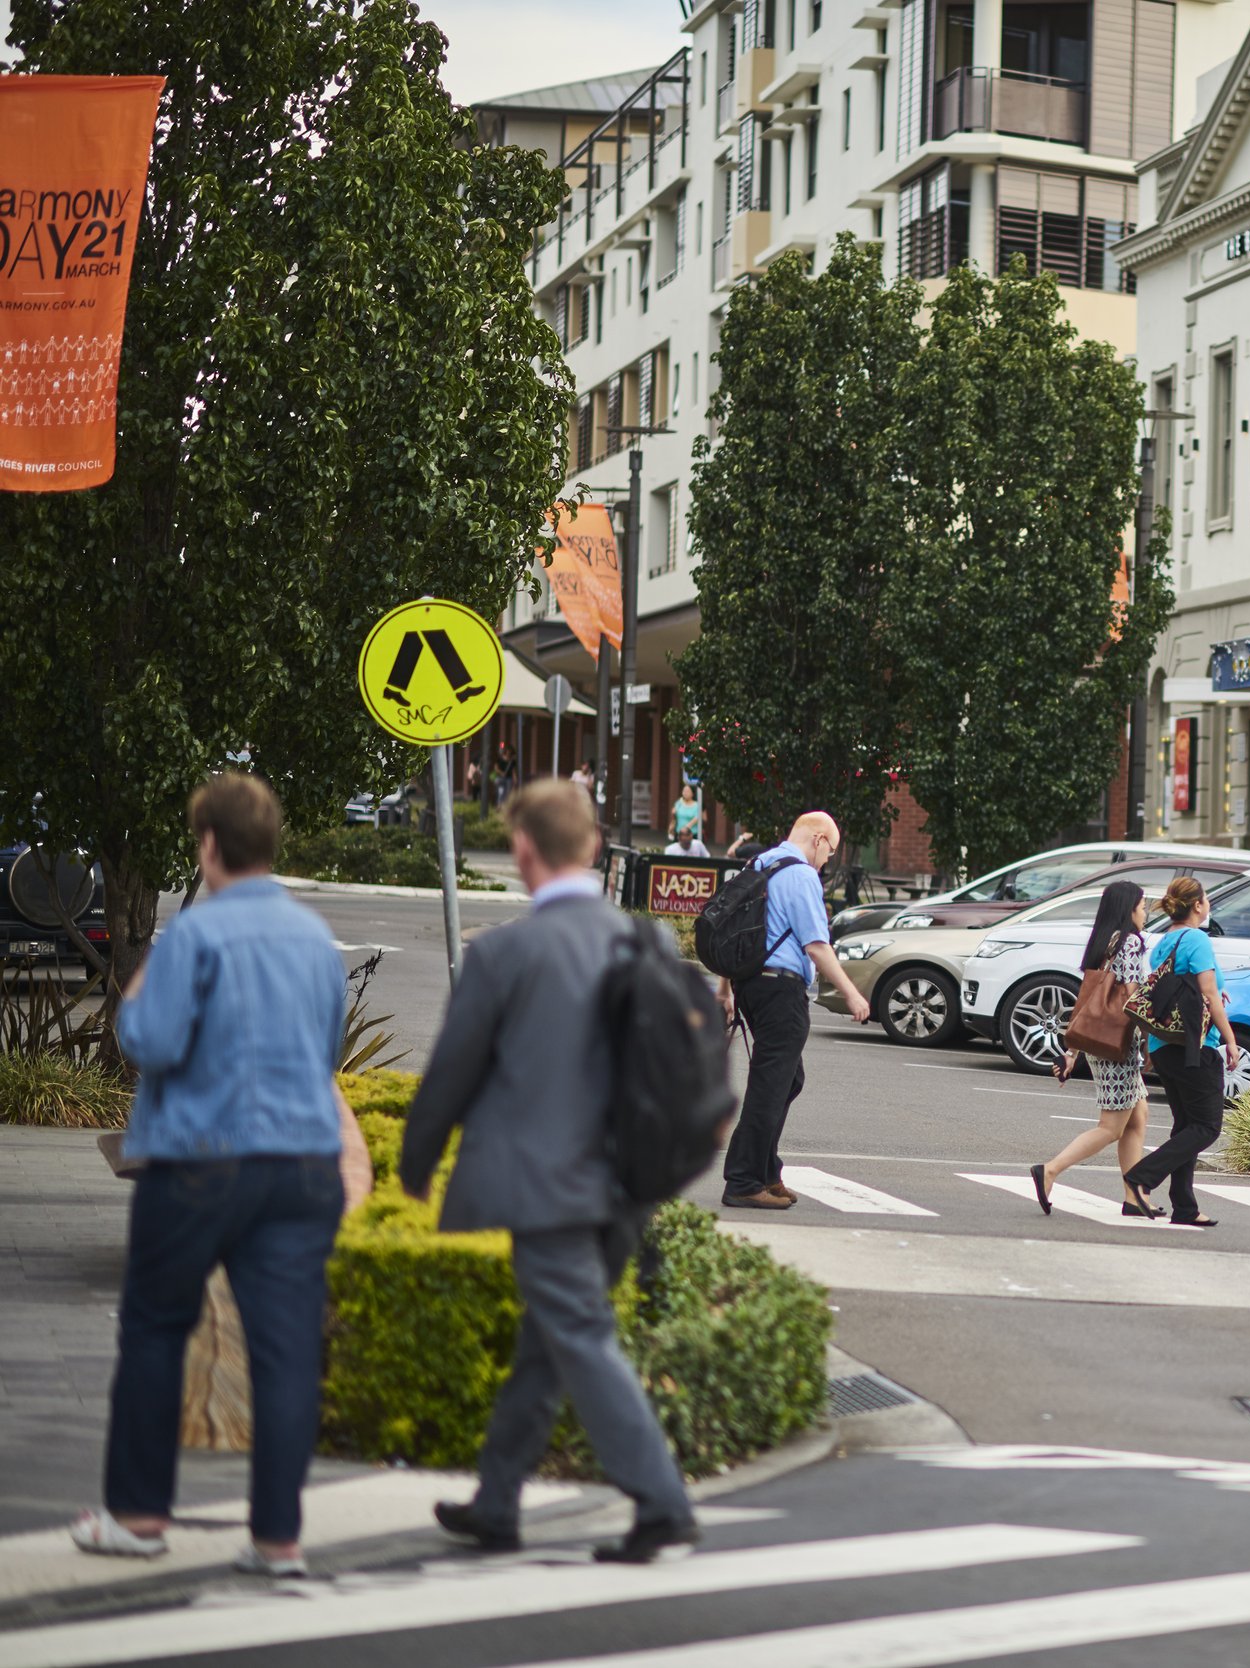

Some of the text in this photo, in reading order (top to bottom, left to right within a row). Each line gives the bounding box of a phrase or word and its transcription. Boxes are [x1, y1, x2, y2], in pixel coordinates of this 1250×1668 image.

[81, 221, 125, 258] 21
[1223, 234, 1242, 260] THE
[65, 262, 120, 278] MARCH
[24, 463, 56, 473] RIVER
[57, 460, 103, 472] COUNCIL
[656, 870, 712, 898] JADE
[653, 899, 669, 910] VIP
